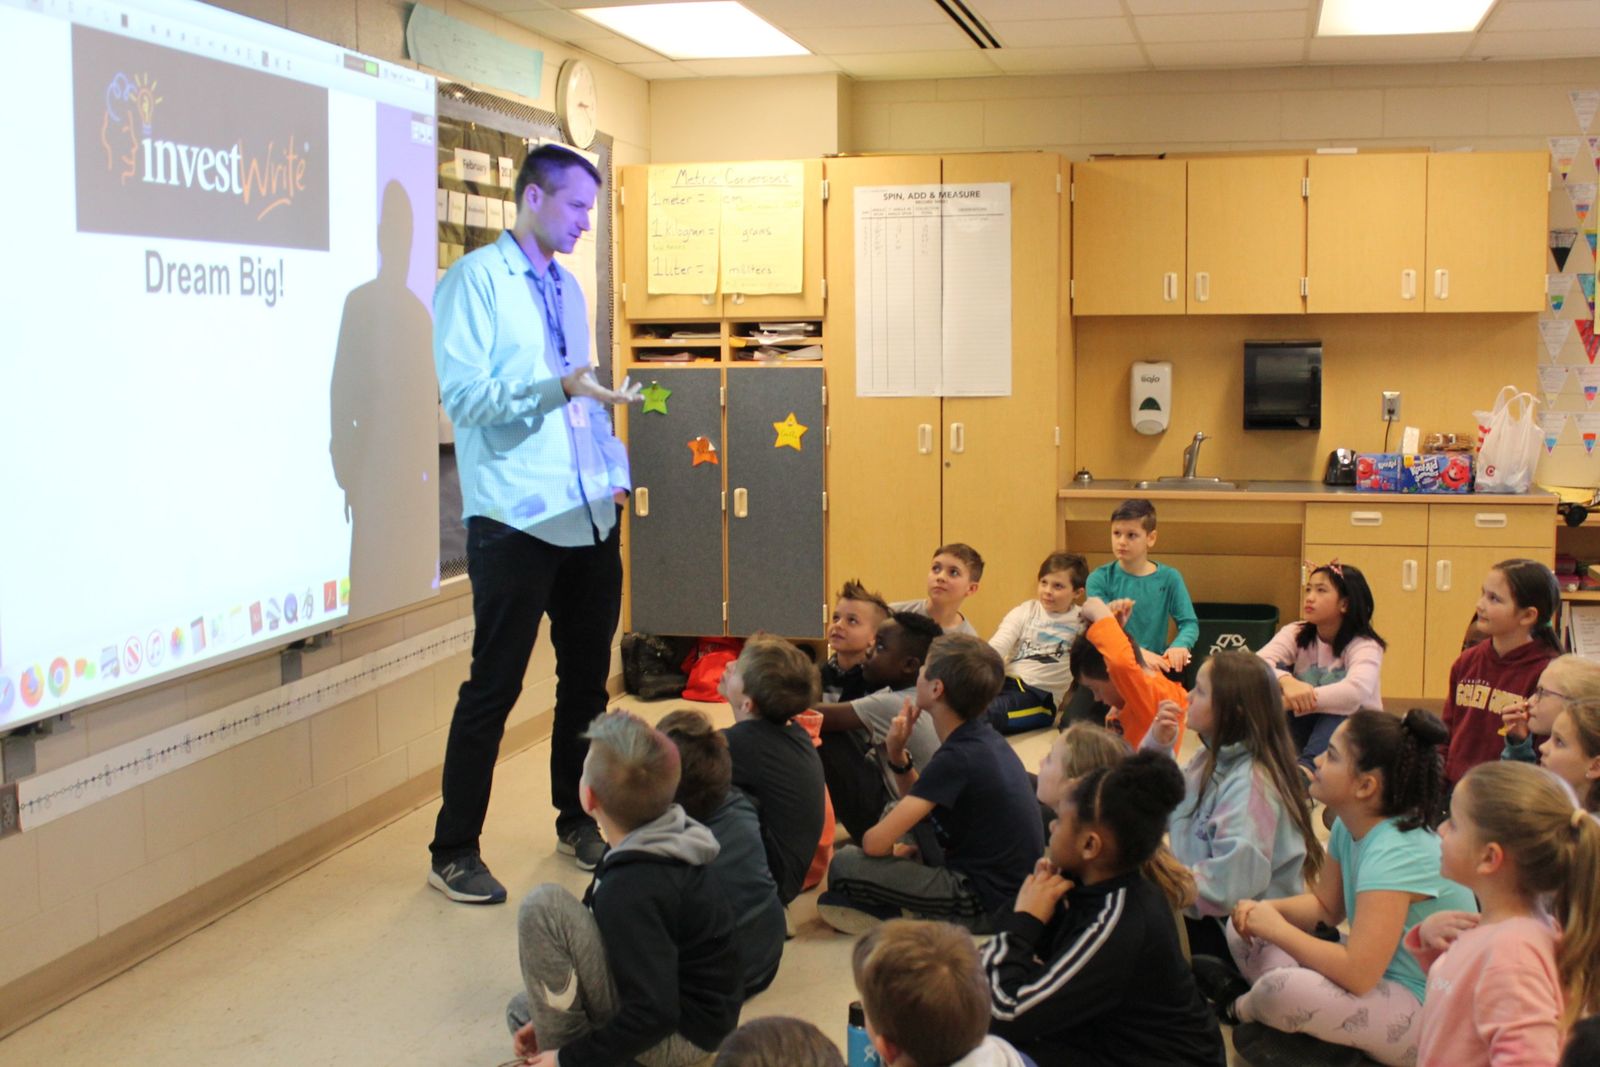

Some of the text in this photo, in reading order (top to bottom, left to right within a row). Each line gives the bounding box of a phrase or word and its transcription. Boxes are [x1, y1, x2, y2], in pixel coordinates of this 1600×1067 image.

[463, 158, 487, 176] February
[662, 191, 693, 206] meter
[883, 192, 905, 201] SPIN,
[908, 191, 927, 200] ADD
[939, 190, 981, 199] MEASURE
[145, 249, 284, 308] Dream Big!
